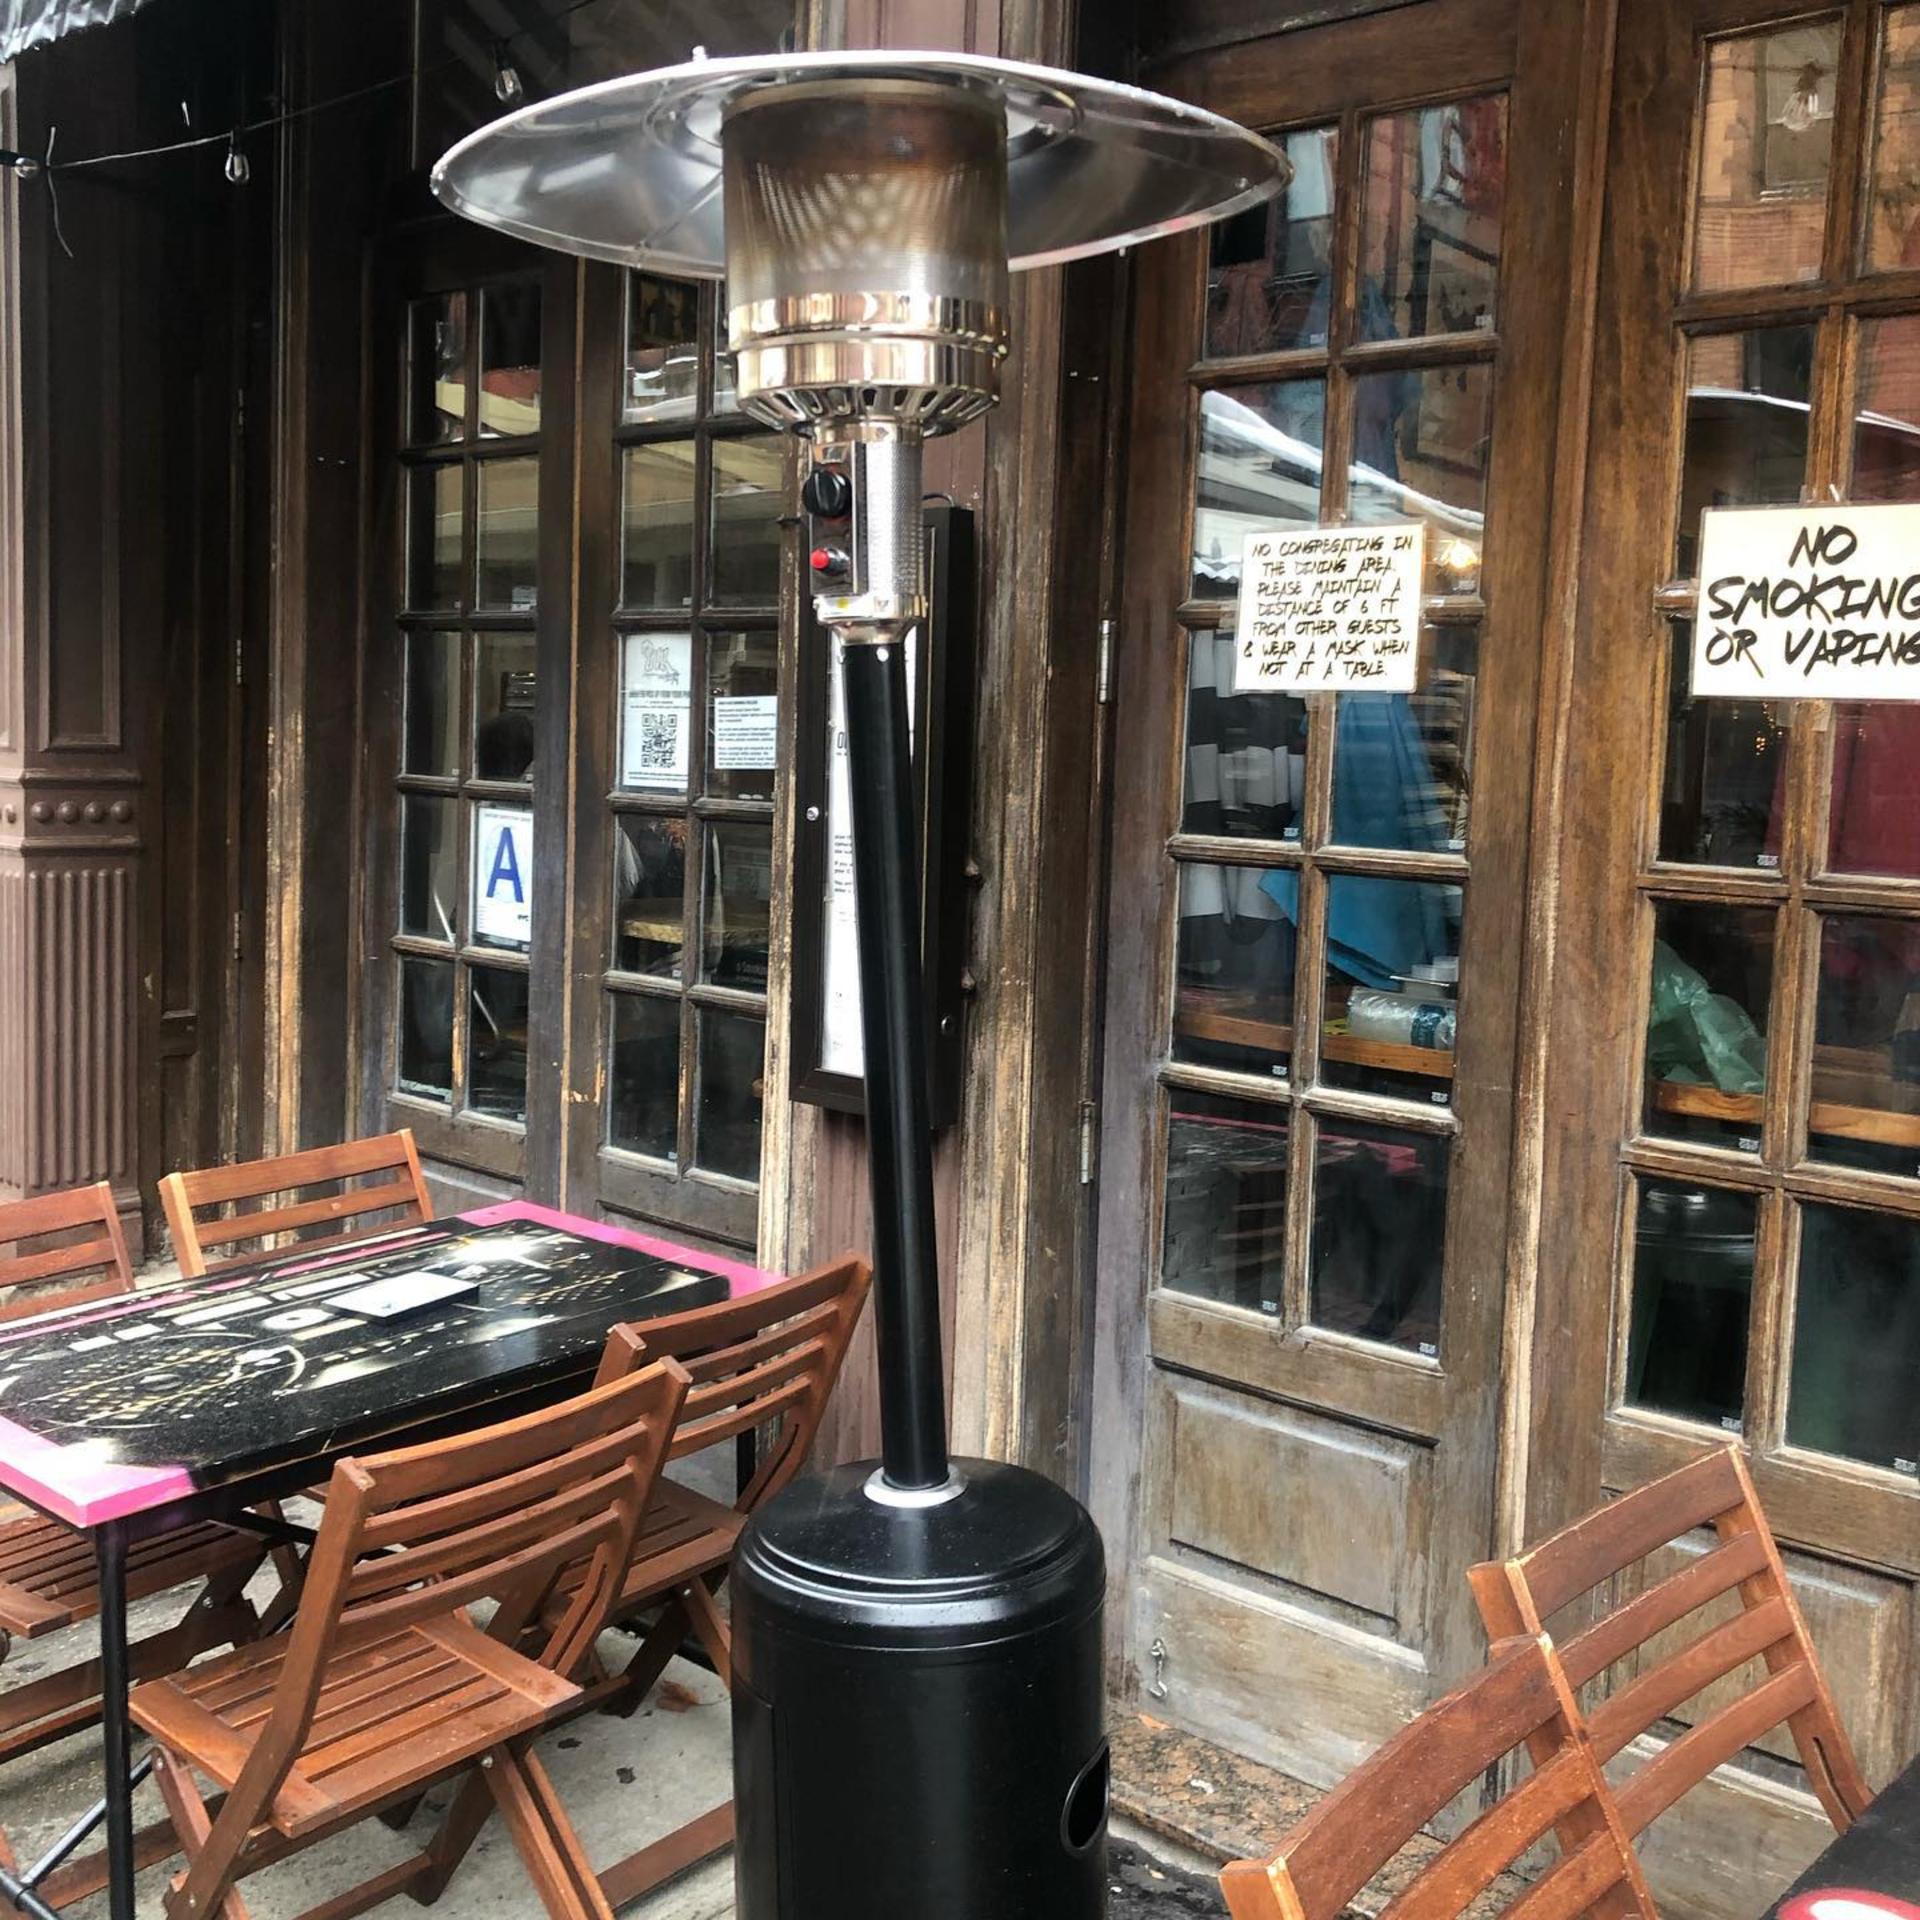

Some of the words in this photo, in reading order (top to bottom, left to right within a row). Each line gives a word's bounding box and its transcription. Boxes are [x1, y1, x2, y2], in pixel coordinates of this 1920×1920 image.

[1252, 543, 1271, 558] NO
[1393, 535, 1413, 551] IN
[1788, 524, 1858, 568] NO
[1262, 561, 1285, 577] THE
[1295, 559, 1347, 575] DINING
[1257, 580, 1302, 598] PLEASE
[1312, 579, 1382, 599] MAINTAIN
[1391, 578, 1401, 597] A
[1258, 600, 1322, 619] DISTANCE
[1333, 599, 1351, 614] OF
[1360, 600, 1369, 614] 6
[1381, 598, 1400, 614] FT
[1707, 574, 1920, 625] SMOKING
[1252, 620, 1287, 638] FROM
[1295, 621, 1338, 638] OTHER
[1347, 619, 1402, 635] GUESTS
[1243, 641, 1254, 658] &
[1262, 641, 1297, 660] WEAR
[1306, 641, 1316, 660] A
[1325, 640, 1366, 659] MASK
[1373, 639, 1411, 656] WHEN
[1705, 626, 1764, 678] OR
[1784, 627, 1920, 677] VAPING
[1258, 661, 1288, 677] NOT
[1295, 661, 1316, 680] AT
[1323, 662, 1333, 680] A
[486, 827, 524, 903] A
